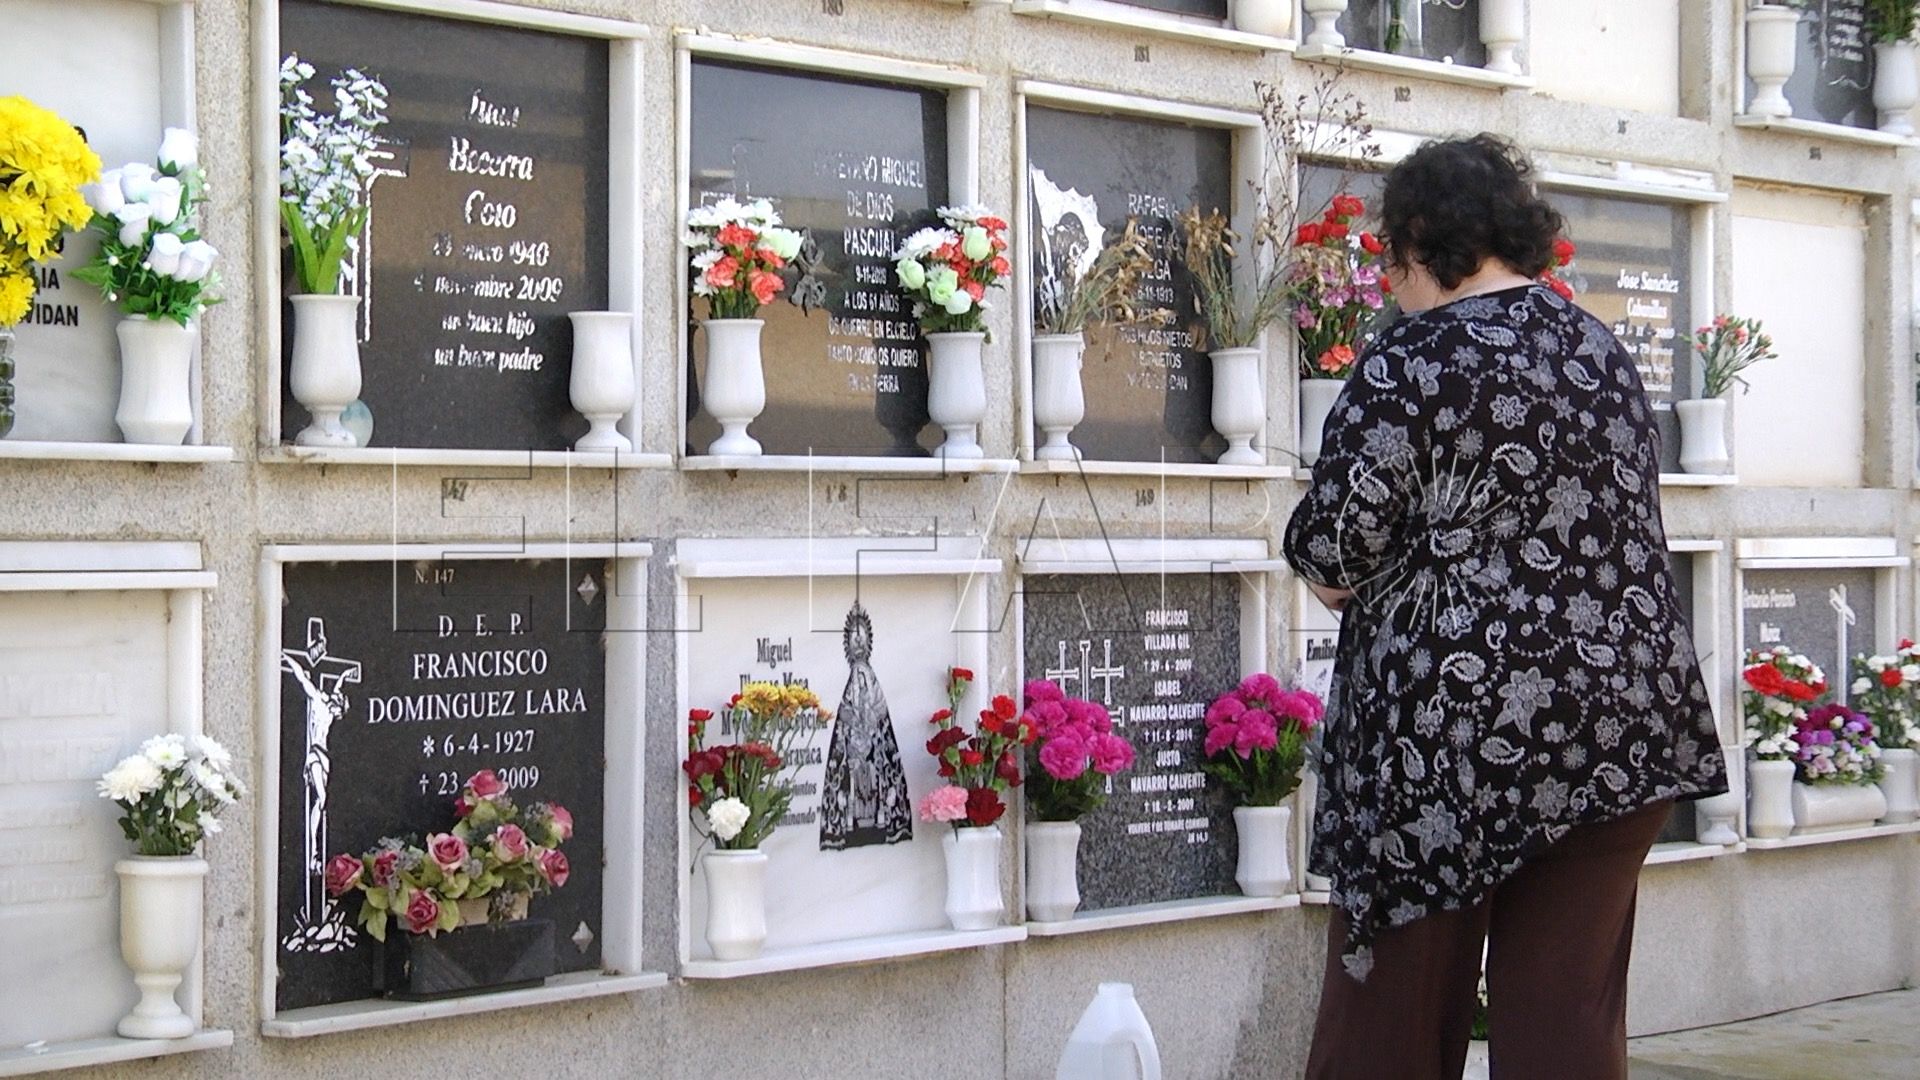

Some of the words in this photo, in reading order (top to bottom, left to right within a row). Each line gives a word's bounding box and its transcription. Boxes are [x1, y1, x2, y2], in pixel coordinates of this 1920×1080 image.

[881, 157, 924, 189] MIGUEL
[866, 191, 894, 222] DIOS
[843, 226, 896, 257] PASCUAL
[517, 275, 563, 303] 2009
[843, 290, 850, 309] A
[852, 291, 867, 310] LOS
[20, 302, 80, 327] VIDAN
[506, 310, 536, 341] hijo
[874, 318, 885, 339] EN
[498, 346, 544, 373] padre
[878, 347, 890, 366] OS
[890, 348, 919, 368] QUIERO
[826, 482, 848, 504] 18
[434, 568, 455, 584] 147
[438, 614, 459, 638] D.
[475, 613, 493, 637] E.
[509, 612, 525, 636] P.
[1145, 609, 1189, 626] FRANCISCO
[756, 637, 793, 669] Miguel
[1144, 633, 1176, 651] VILLADA
[412, 648, 548, 681] FRANCISCO
[1154, 679, 1181, 697] ISABEL
[367, 689, 517, 725] DOMINGUEZ
[524, 687, 588, 715] LARA
[1130, 704, 1168, 722] NAVARRO
[1168, 702, 1205, 720] CALVENTE
[783, 746, 823, 767] ravaca
[1156, 749, 1181, 768] JUSTO
[1130, 774, 1168, 793] NAVARRO
[1168, 771, 1206, 790] CALVENTE
